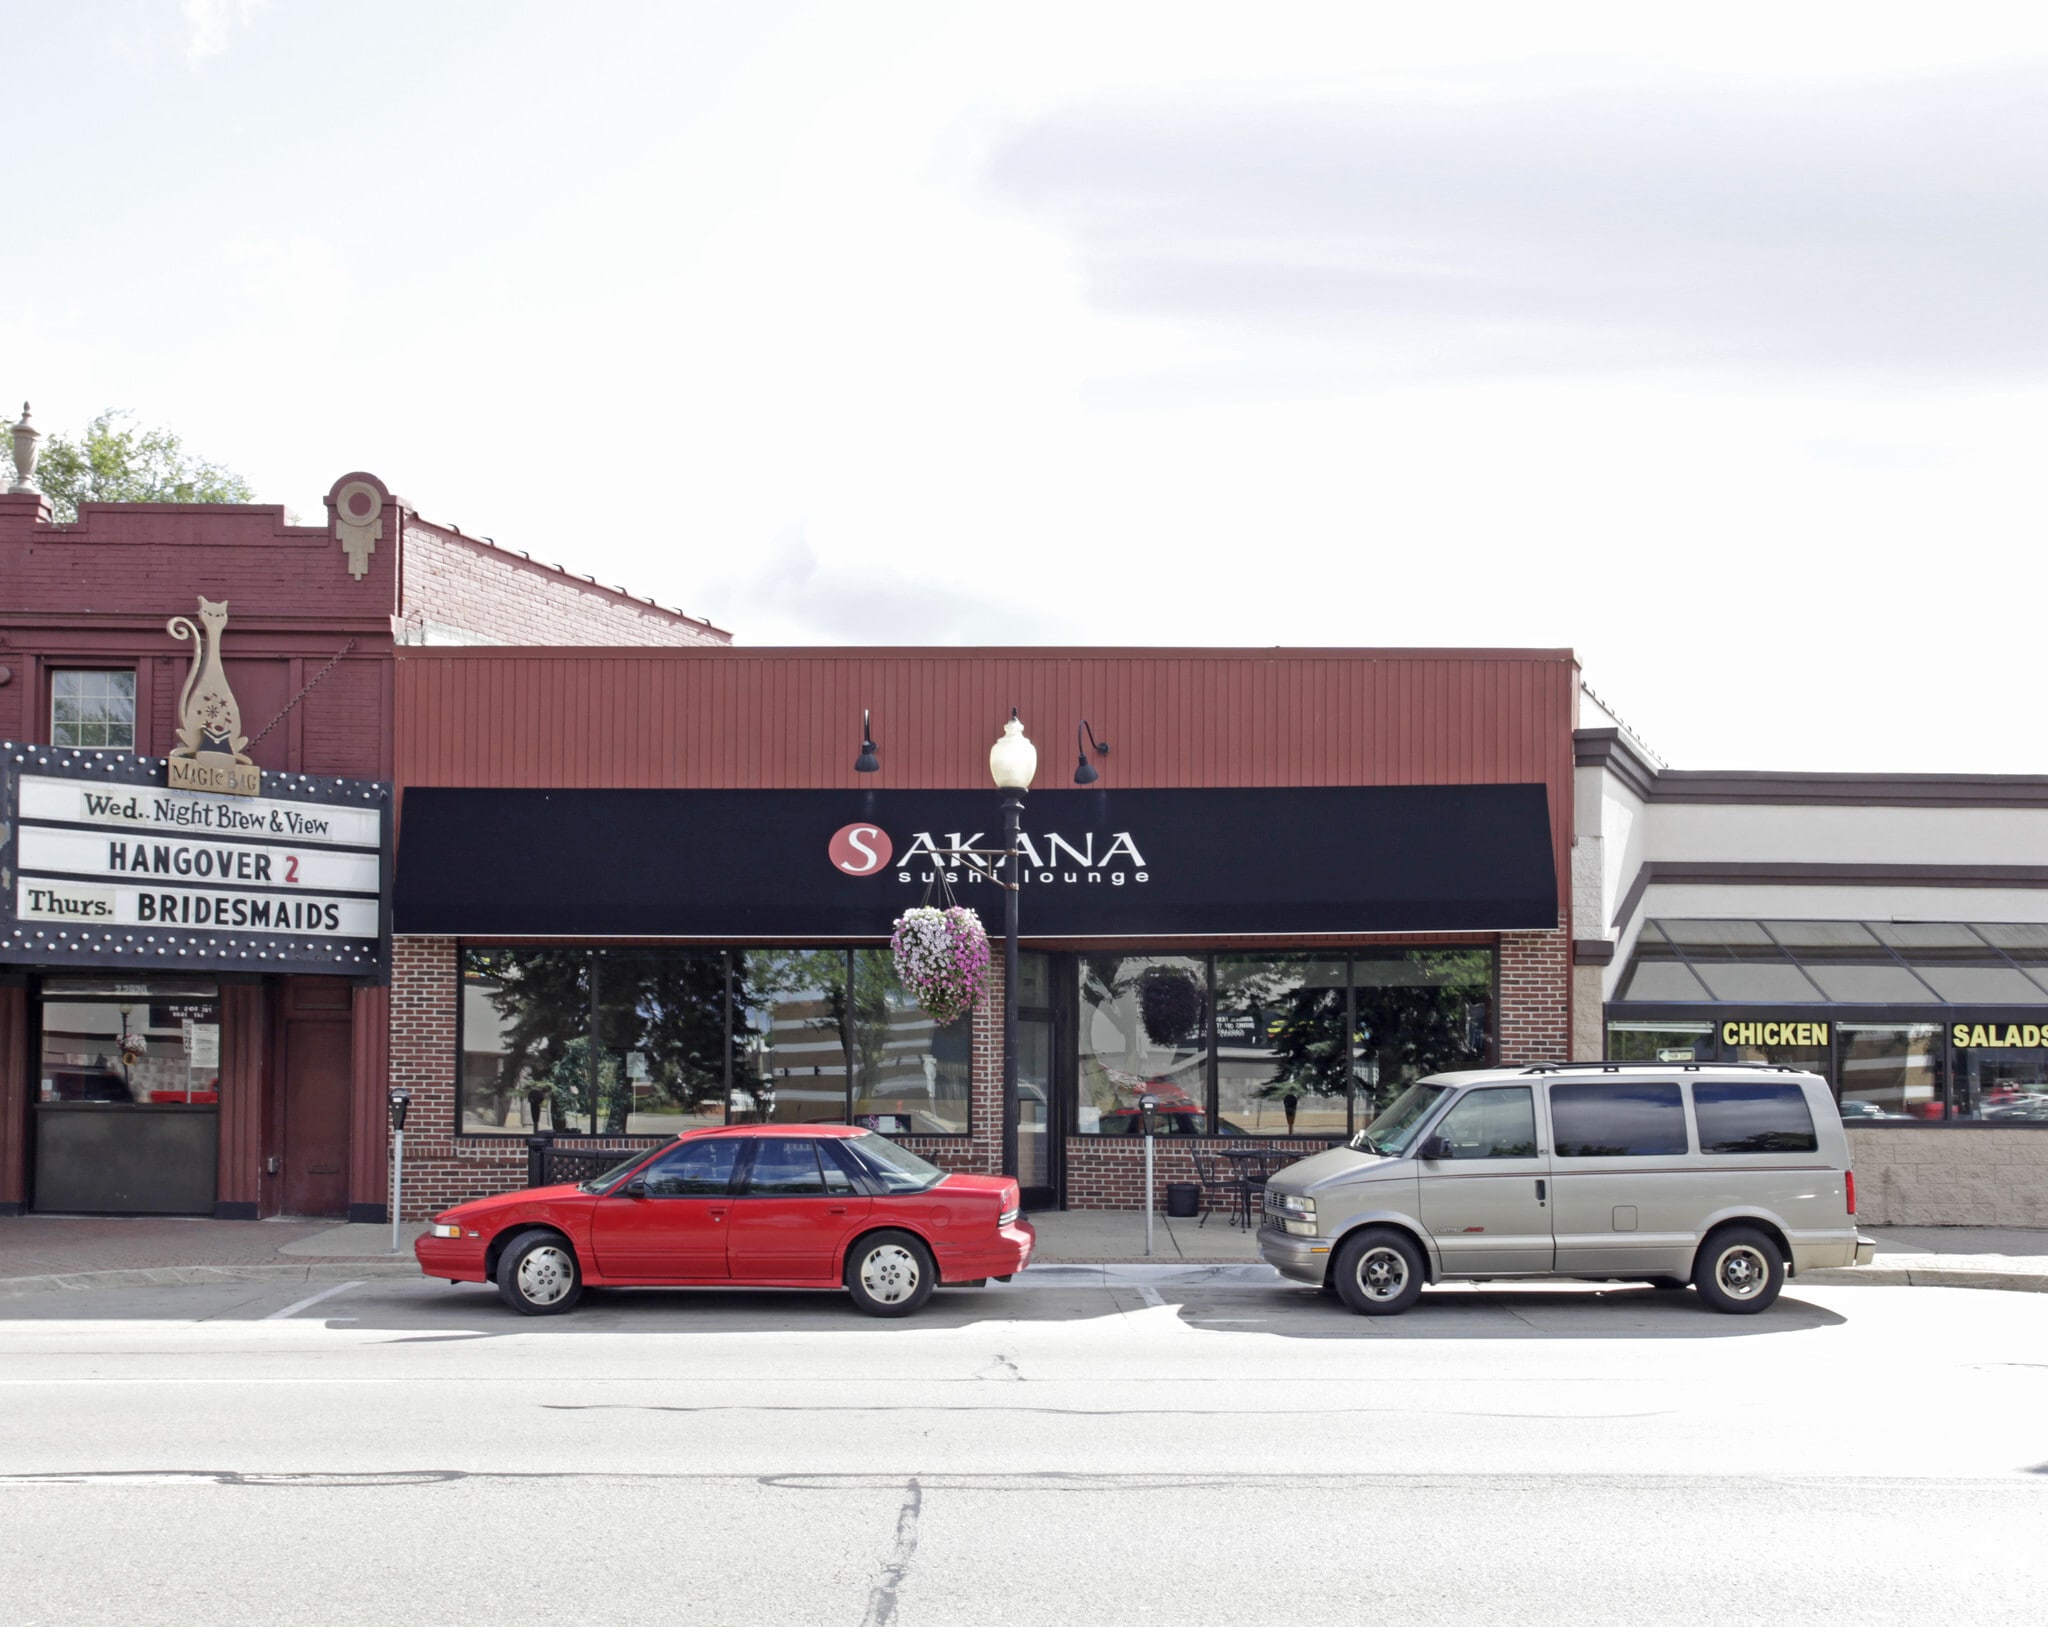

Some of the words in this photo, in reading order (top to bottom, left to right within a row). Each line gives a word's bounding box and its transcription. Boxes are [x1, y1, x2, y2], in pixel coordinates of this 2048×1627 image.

[154, 799, 214, 826] Night
[217, 804, 266, 830] Brew
[270, 809, 284, 832] &
[284, 811, 329, 835] View
[109, 841, 272, 881] HANGOVER
[285, 855, 299, 884] 2
[898, 869, 998, 883] sushi
[1024, 869, 1149, 886] lounge
[28, 889, 113, 916] Thurs.
[138, 893, 340, 930] BRIDESMAIDS
[1722, 1022, 1829, 1046] CHICKEN
